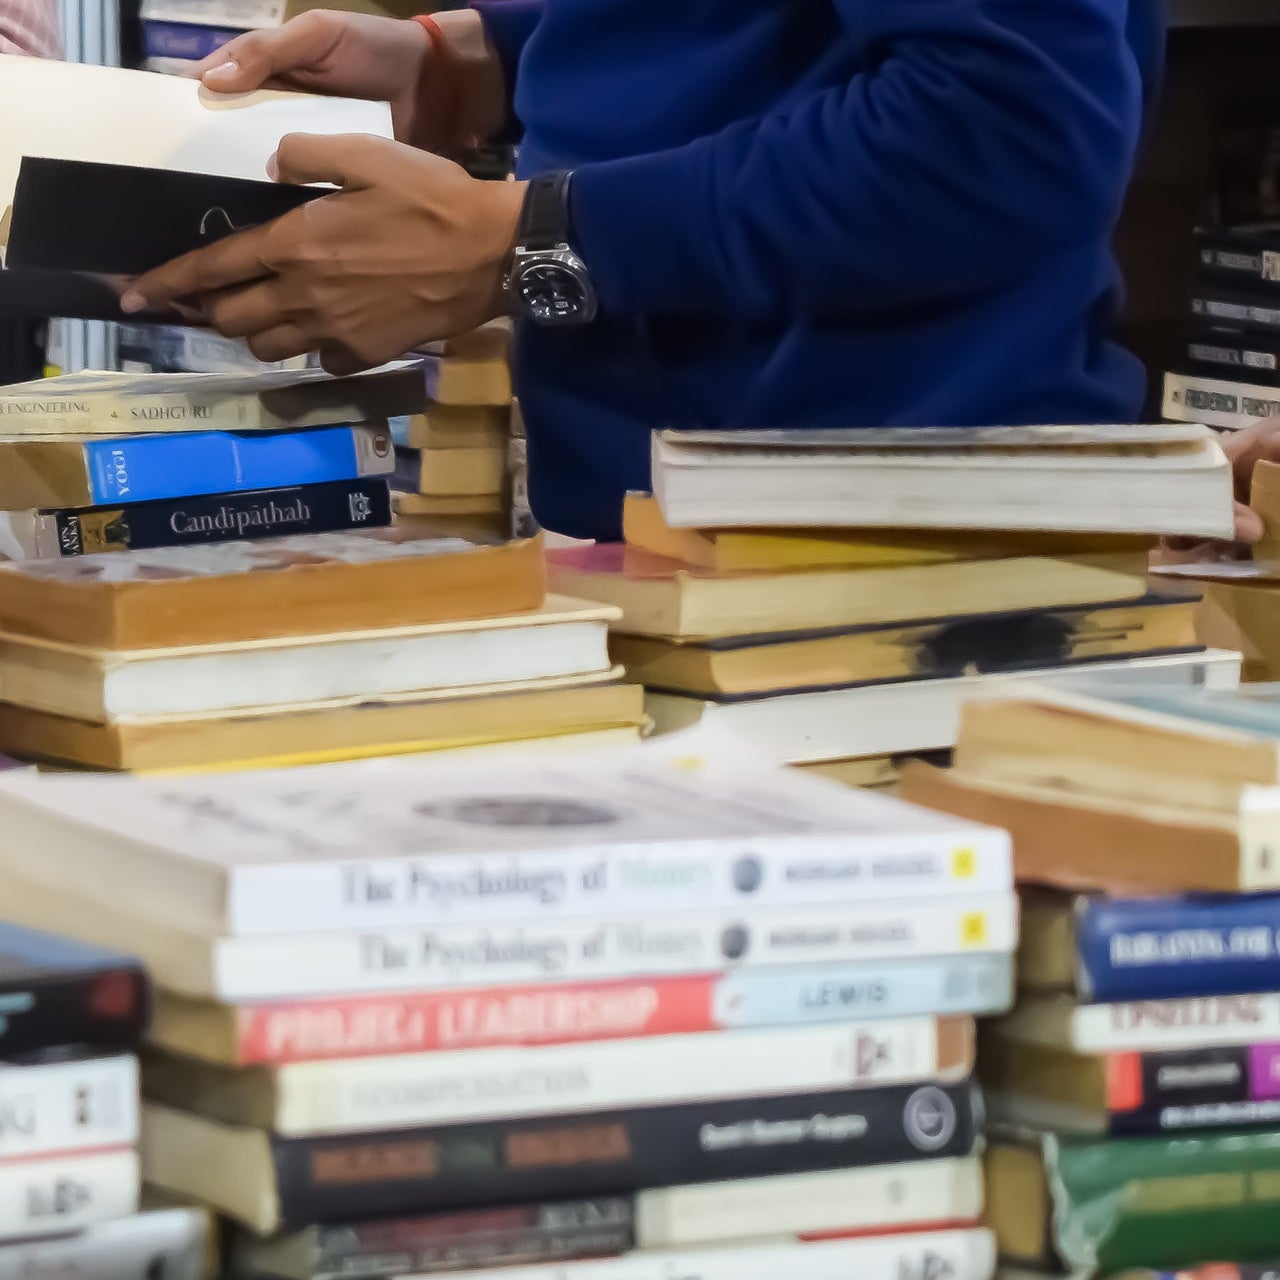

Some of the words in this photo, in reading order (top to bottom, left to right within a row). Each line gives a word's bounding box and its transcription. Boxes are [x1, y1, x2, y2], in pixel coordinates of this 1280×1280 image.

[130, 404, 213, 421] SADHGURU
[111, 449, 131, 497] YOGI
[340, 864, 394, 907] The
[407, 854, 567, 907] Psychology
[580, 859, 609, 891] of
[620, 856, 713, 894] Money
[358, 932, 408, 971] The
[419, 923, 570, 972] Psychology
[581, 927, 609, 959] of
[616, 924, 706, 959] Money
[797, 978, 890, 1010] LEWIS
[264, 1006, 427, 1059] PROJECT
[436, 985, 660, 1046] LEADERSHIP
